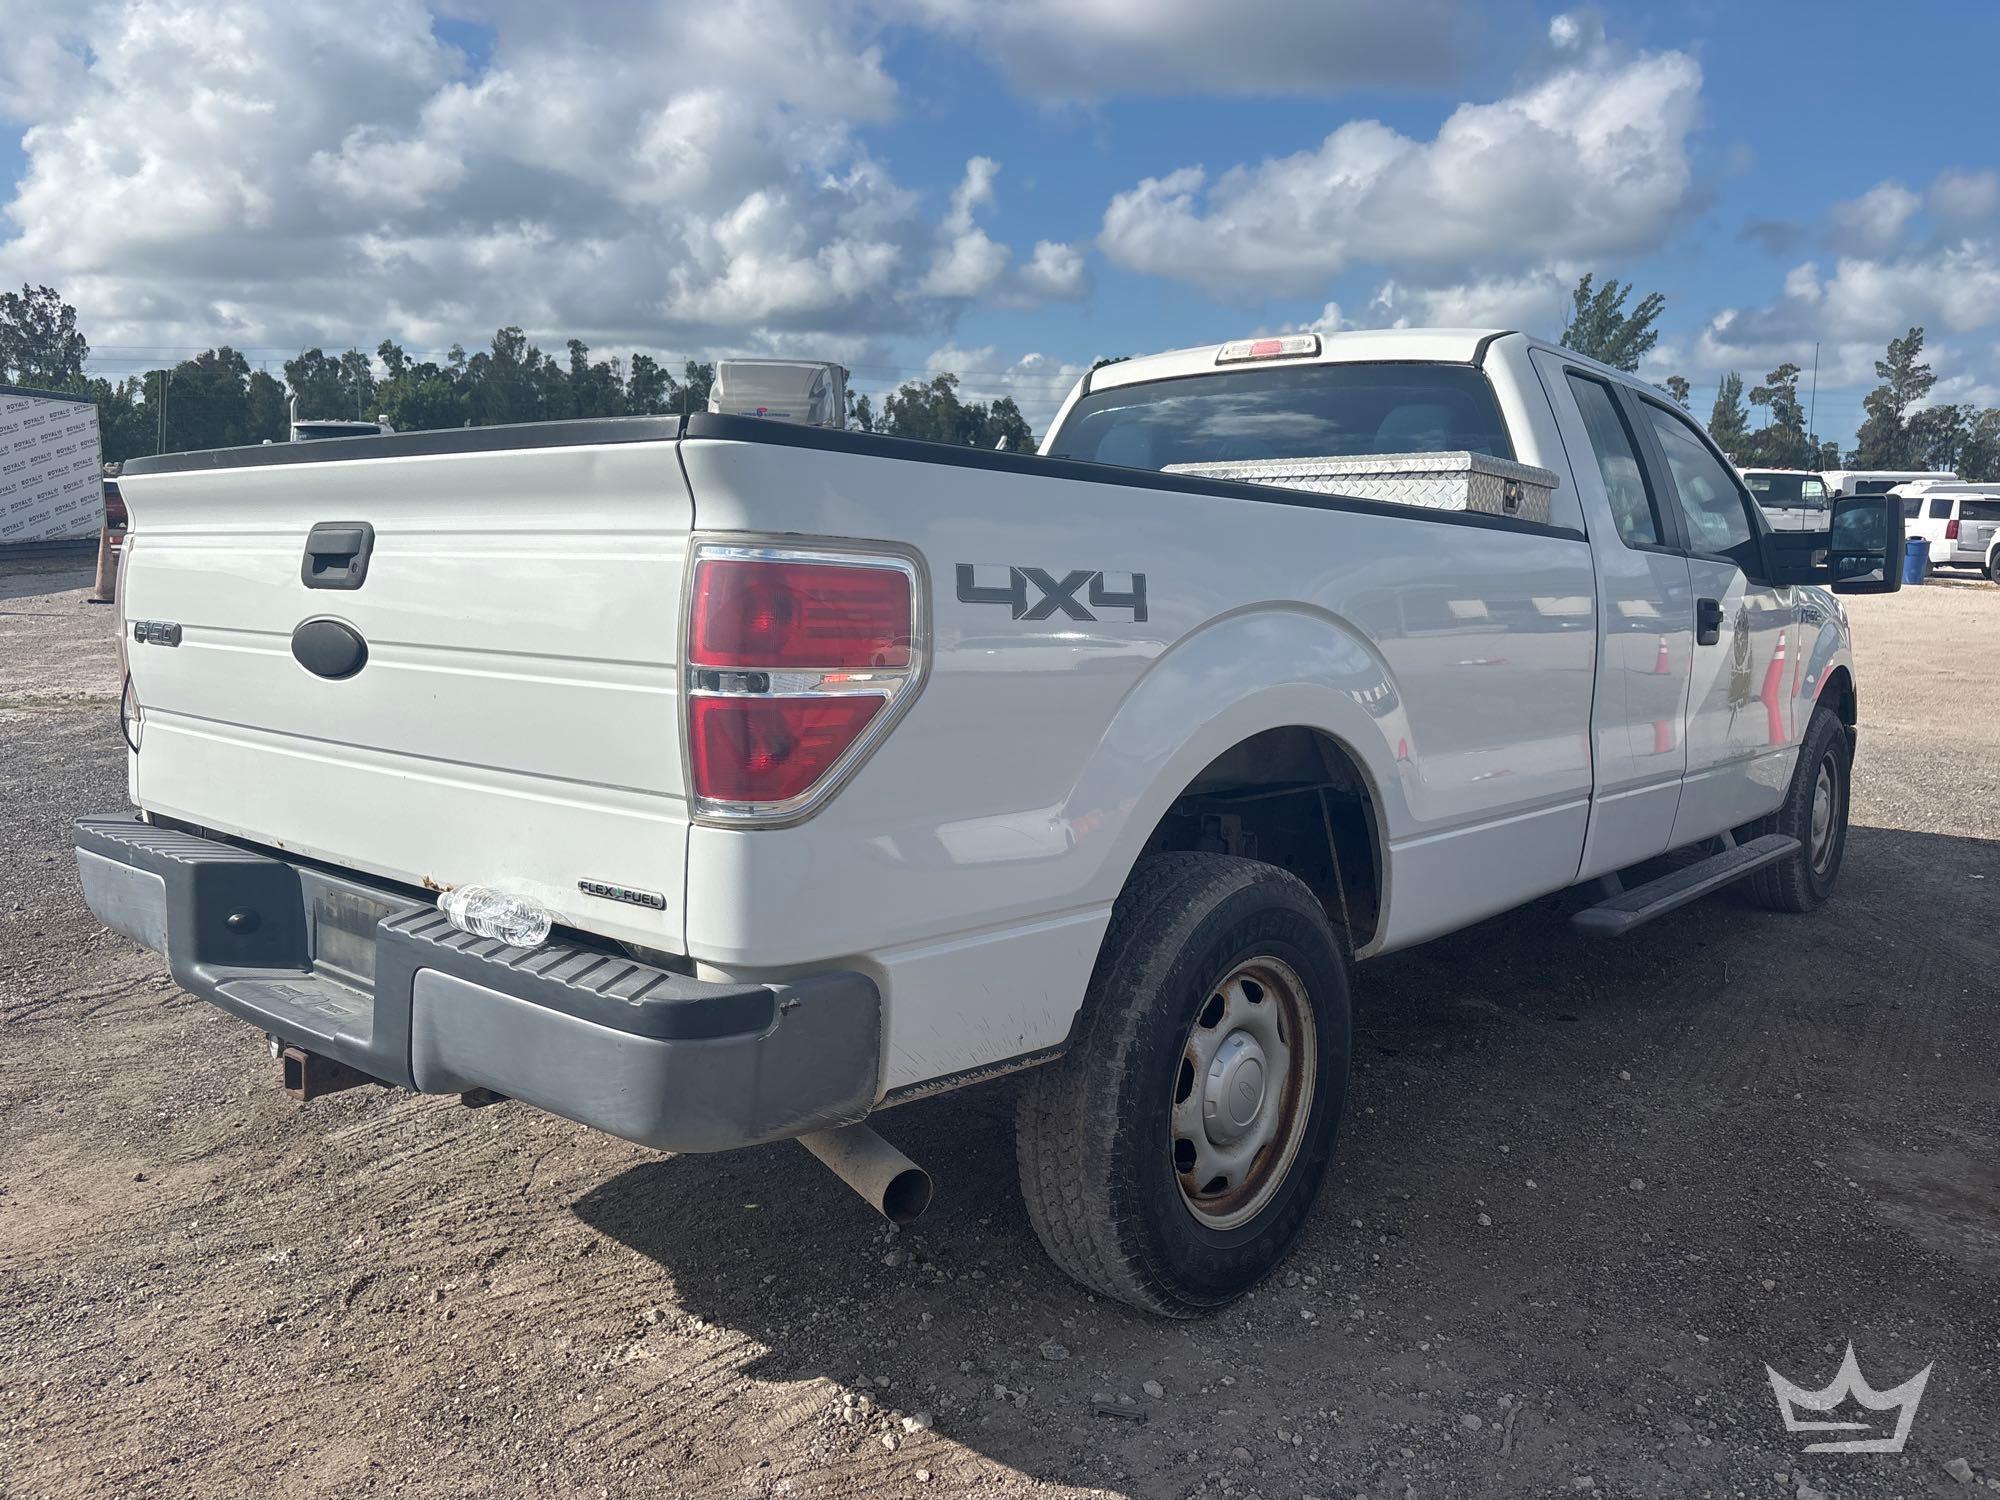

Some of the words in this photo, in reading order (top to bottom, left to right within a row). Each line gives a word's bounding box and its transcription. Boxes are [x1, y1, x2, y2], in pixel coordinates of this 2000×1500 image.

[955, 563, 1148, 622] 4X4
[580, 881, 614, 897] FLEX
[623, 890, 659, 906] FUEL
